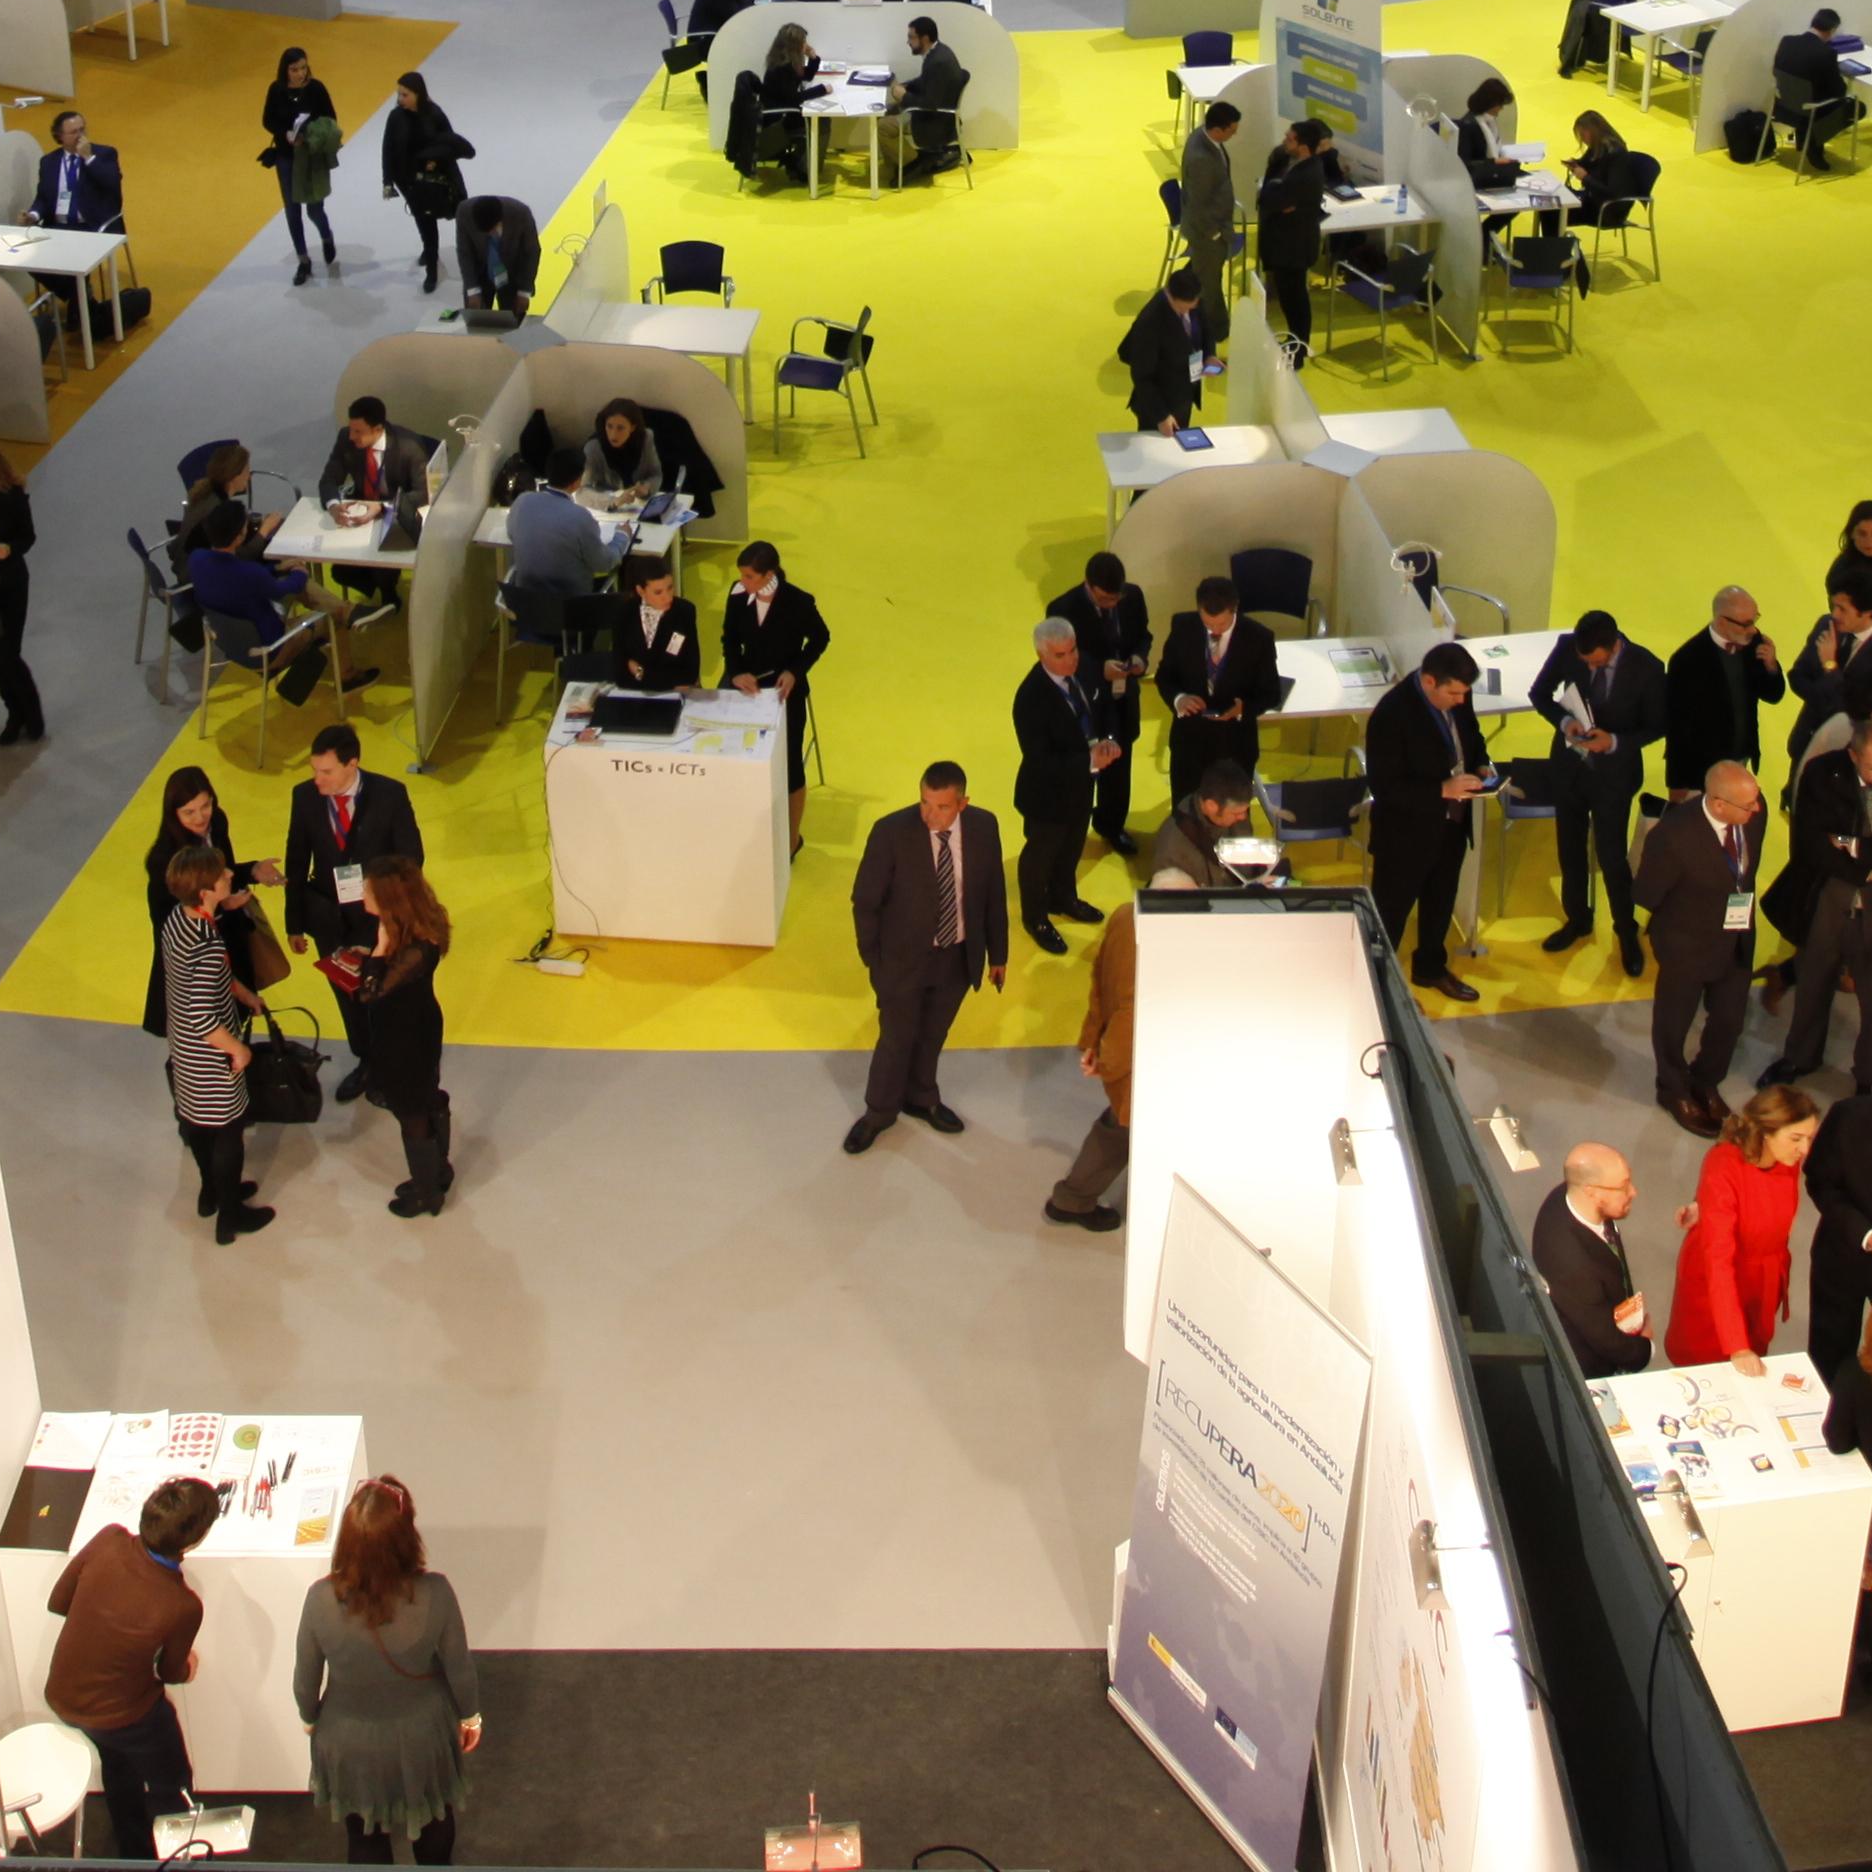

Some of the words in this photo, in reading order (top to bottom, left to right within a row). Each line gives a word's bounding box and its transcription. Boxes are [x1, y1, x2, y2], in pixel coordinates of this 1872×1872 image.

[1301, 4, 1354, 31] SOLBYTE
[610, 758, 652, 774] TICs
[669, 762, 706, 776] ICTs
[1166, 1314, 1217, 1368] valorización
[1217, 1363, 1228, 1379] de
[1228, 1375, 1237, 1390] la
[1237, 1387, 1287, 1438] agricultura
[1286, 1431, 1299, 1449] en
[1300, 1444, 1344, 1495] Andalucía
[1167, 1298, 1186, 1323] Una
[1187, 1319, 1238, 1374] oportunidad
[1238, 1369, 1259, 1395] para
[1260, 1389, 1270, 1405] la
[1270, 1400, 1338, 1470] modernización
[1337, 1469, 1345, 1480] y
[1156, 1448, 1171, 1513] OBJETIVOS
